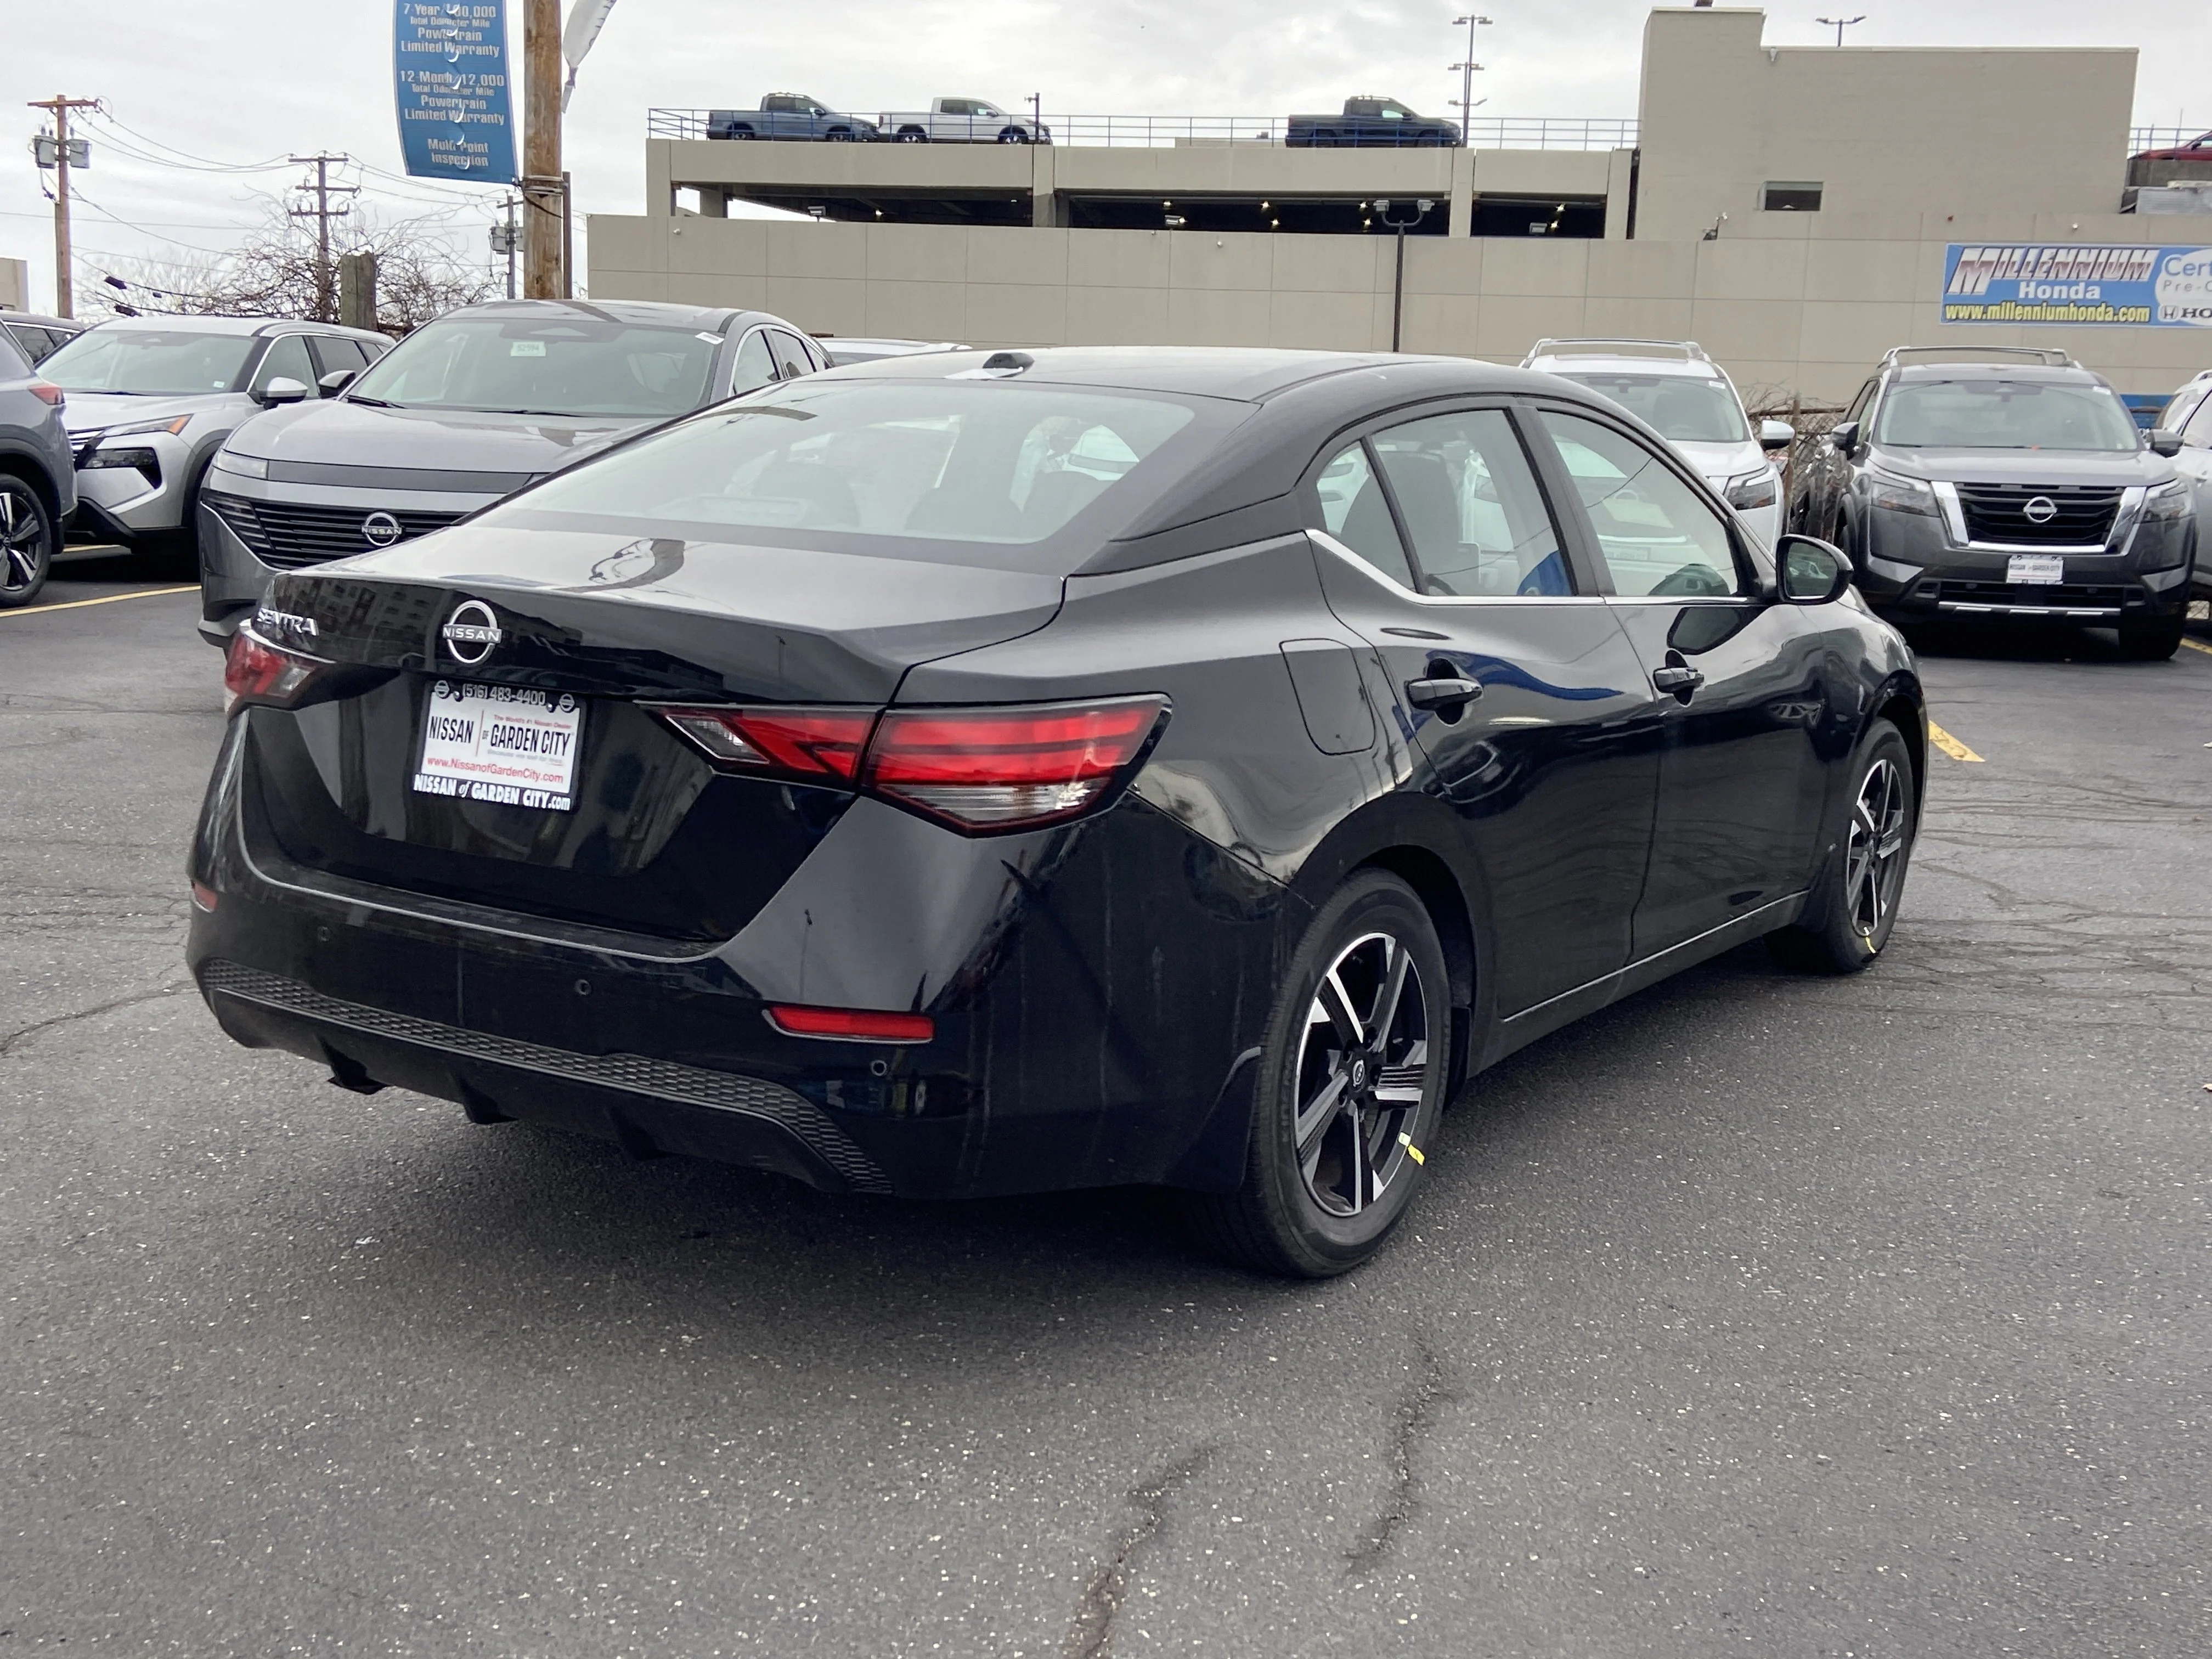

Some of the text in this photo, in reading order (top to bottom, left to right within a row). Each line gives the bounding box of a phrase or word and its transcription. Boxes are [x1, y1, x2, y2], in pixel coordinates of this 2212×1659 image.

[410, 16, 428, 25] Total
[472, 19, 490, 28] Mile
[401, 40, 500, 58] Limited Warranty
[412, 84, 430, 93] Total
[476, 87, 495, 96] Mile
[421, 95, 487, 110] Powertrain
[405, 108, 505, 126] Limited Warranty
[432, 153, 489, 166] Inspection
[1946, 247, 2160, 296] MILLENNIUM
[2019, 281, 2101, 300] Honda
[1945, 302, 2149, 323] www.millenniumhonda.com
[362, 527, 402, 535] NISSAN
[257, 607, 319, 636] SENTRA
[443, 626, 500, 642] NISSAN
[462, 684, 546, 706] (516) 483-4400
[428, 715, 474, 743] NISSAN
[491, 724, 540, 753] GARDEN
[541, 730, 571, 756] CITY
[427, 757, 563, 783] www.NissanofGardenCity.com
[414, 774, 457, 797] NISSAN
[459, 781, 471, 798] of
[471, 782, 521, 805] GARDEN
